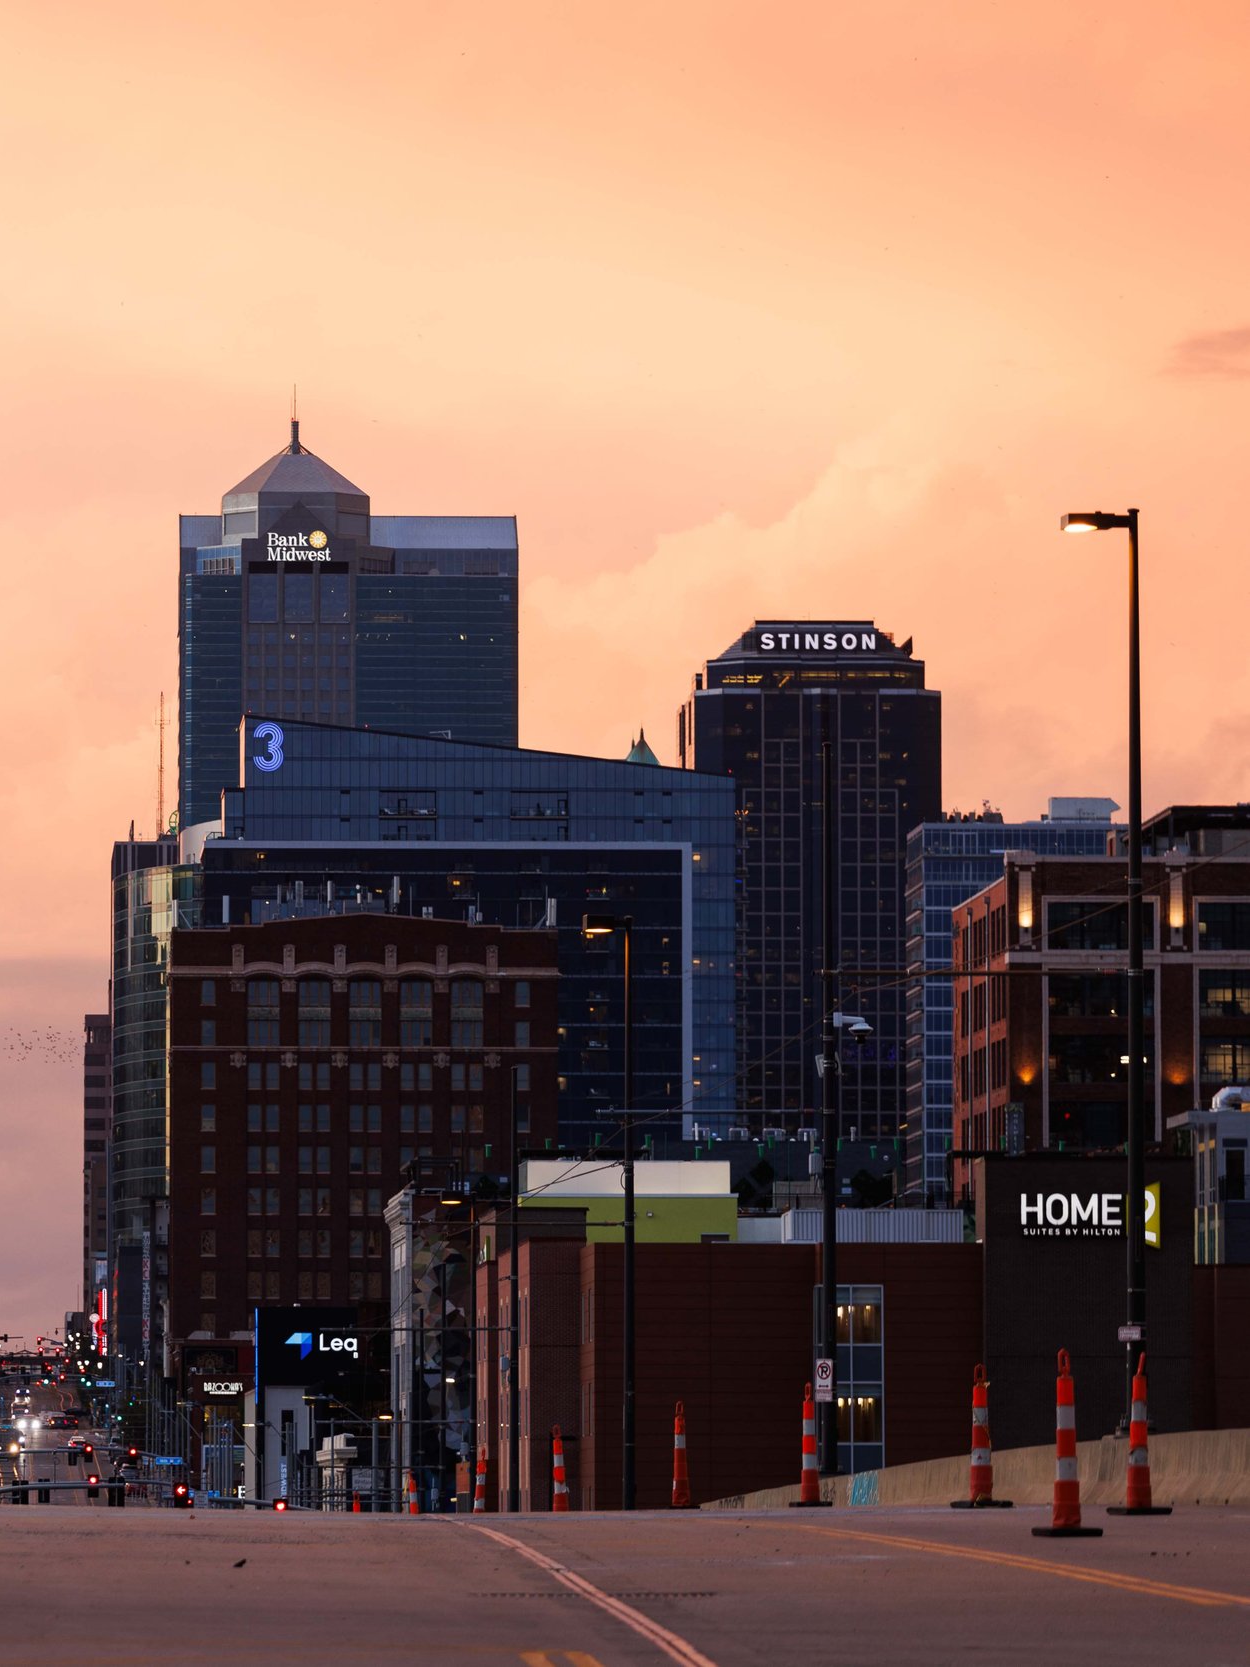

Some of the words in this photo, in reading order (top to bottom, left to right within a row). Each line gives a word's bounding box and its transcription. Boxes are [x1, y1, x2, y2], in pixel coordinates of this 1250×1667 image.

[267, 532, 309, 547] Bank
[267, 547, 331, 561] Midwest
[760, 633, 876, 650] STINSON
[253, 722, 284, 772] 3
[1020, 1193, 1122, 1226] HOME
[1023, 1228, 1060, 1236] SUITES
[1065, 1228, 1078, 1236] BY
[1082, 1228, 1121, 1236] HILTON
